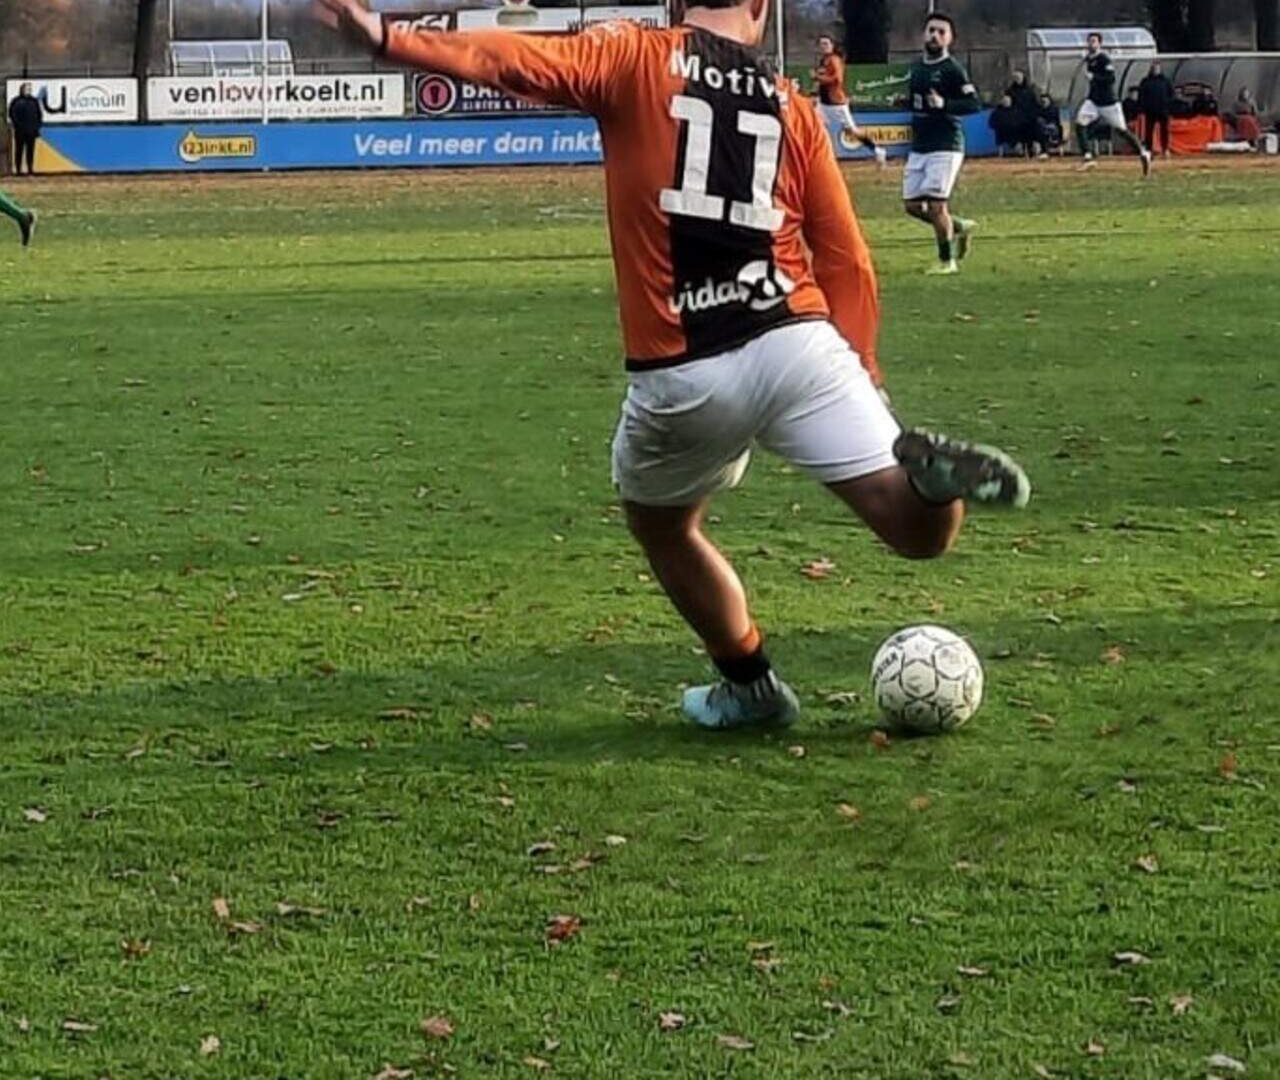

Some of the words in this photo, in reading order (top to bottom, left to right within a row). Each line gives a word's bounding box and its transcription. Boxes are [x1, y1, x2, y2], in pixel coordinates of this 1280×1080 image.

[169, 79, 384, 104] venloverkoelt.nl
[354, 132, 411, 157] Veel
[419, 135, 486, 156] meer
[494, 131, 544, 154] dan
[552, 130, 602, 153] inkt
[660, 95, 786, 231] 11
